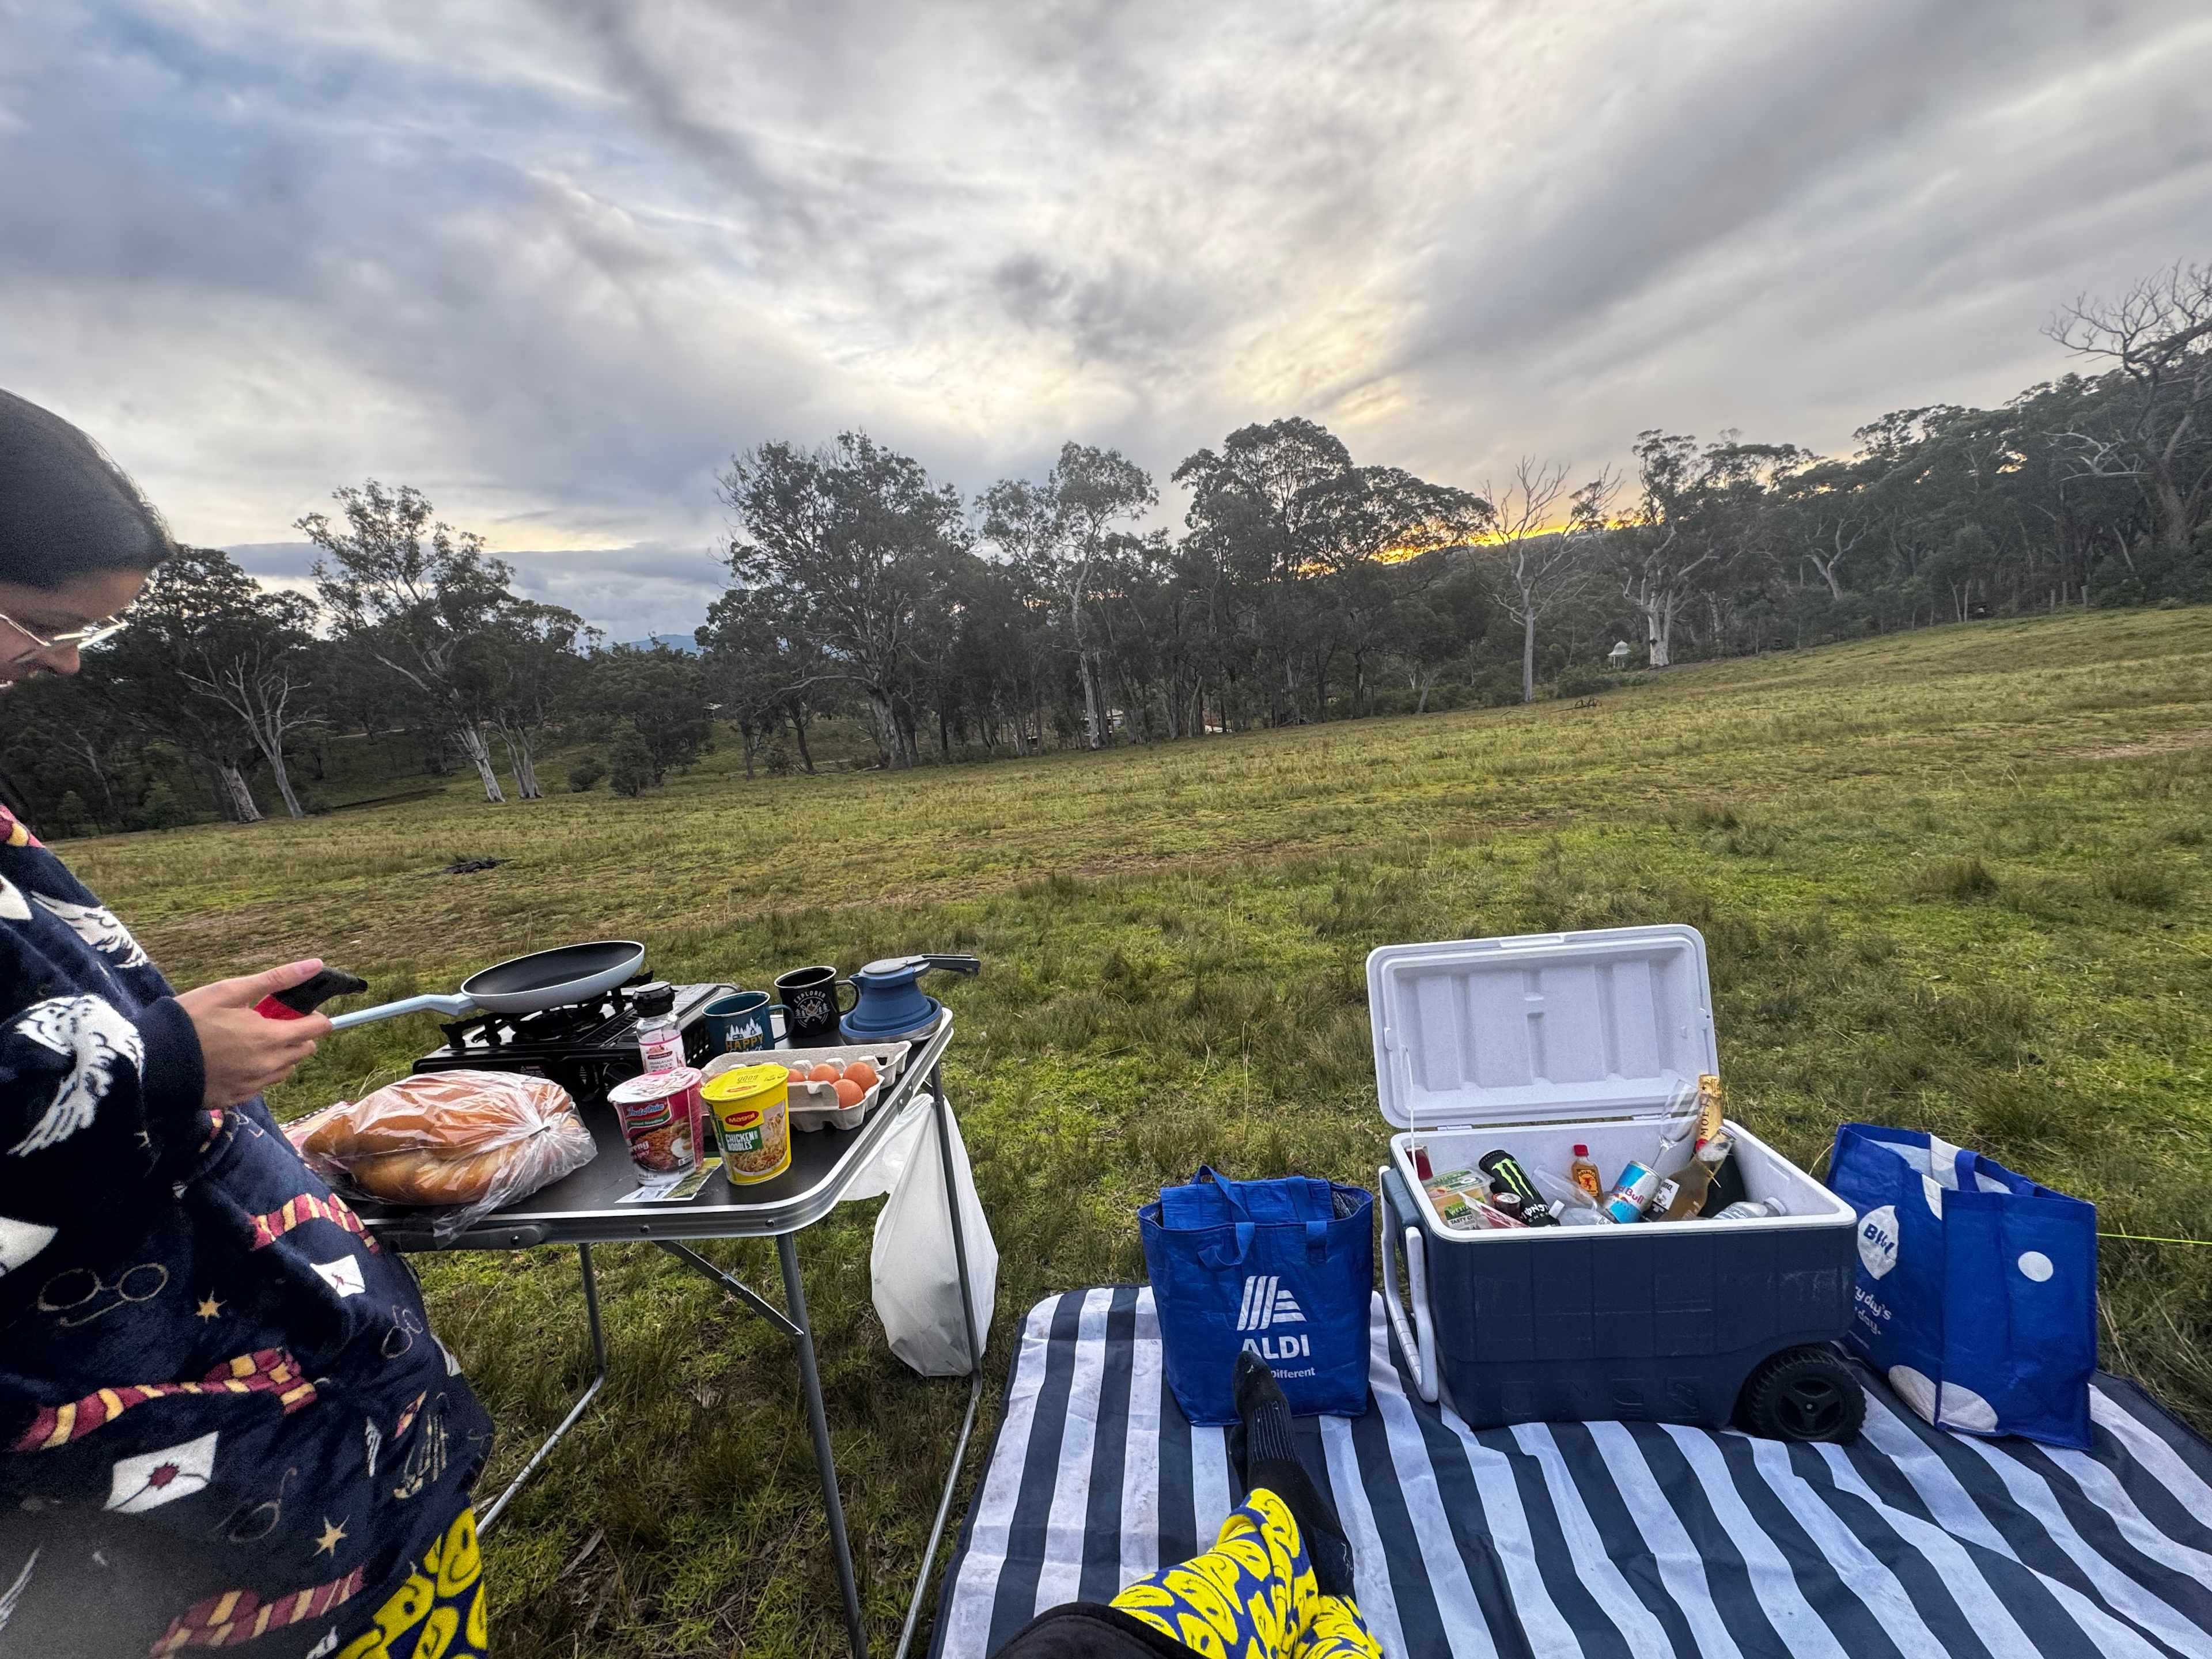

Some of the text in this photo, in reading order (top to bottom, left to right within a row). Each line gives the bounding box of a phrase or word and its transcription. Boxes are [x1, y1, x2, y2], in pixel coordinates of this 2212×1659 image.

[793, 990, 826, 1004] EXPLORER
[725, 1033, 764, 1051] HAPPY
[725, 1131, 755, 1143] CHICKEN
[727, 1141, 753, 1152] NOODLES
[1625, 1188, 1645, 1205] Bull
[1242, 1334, 1310, 1359] ALDI
